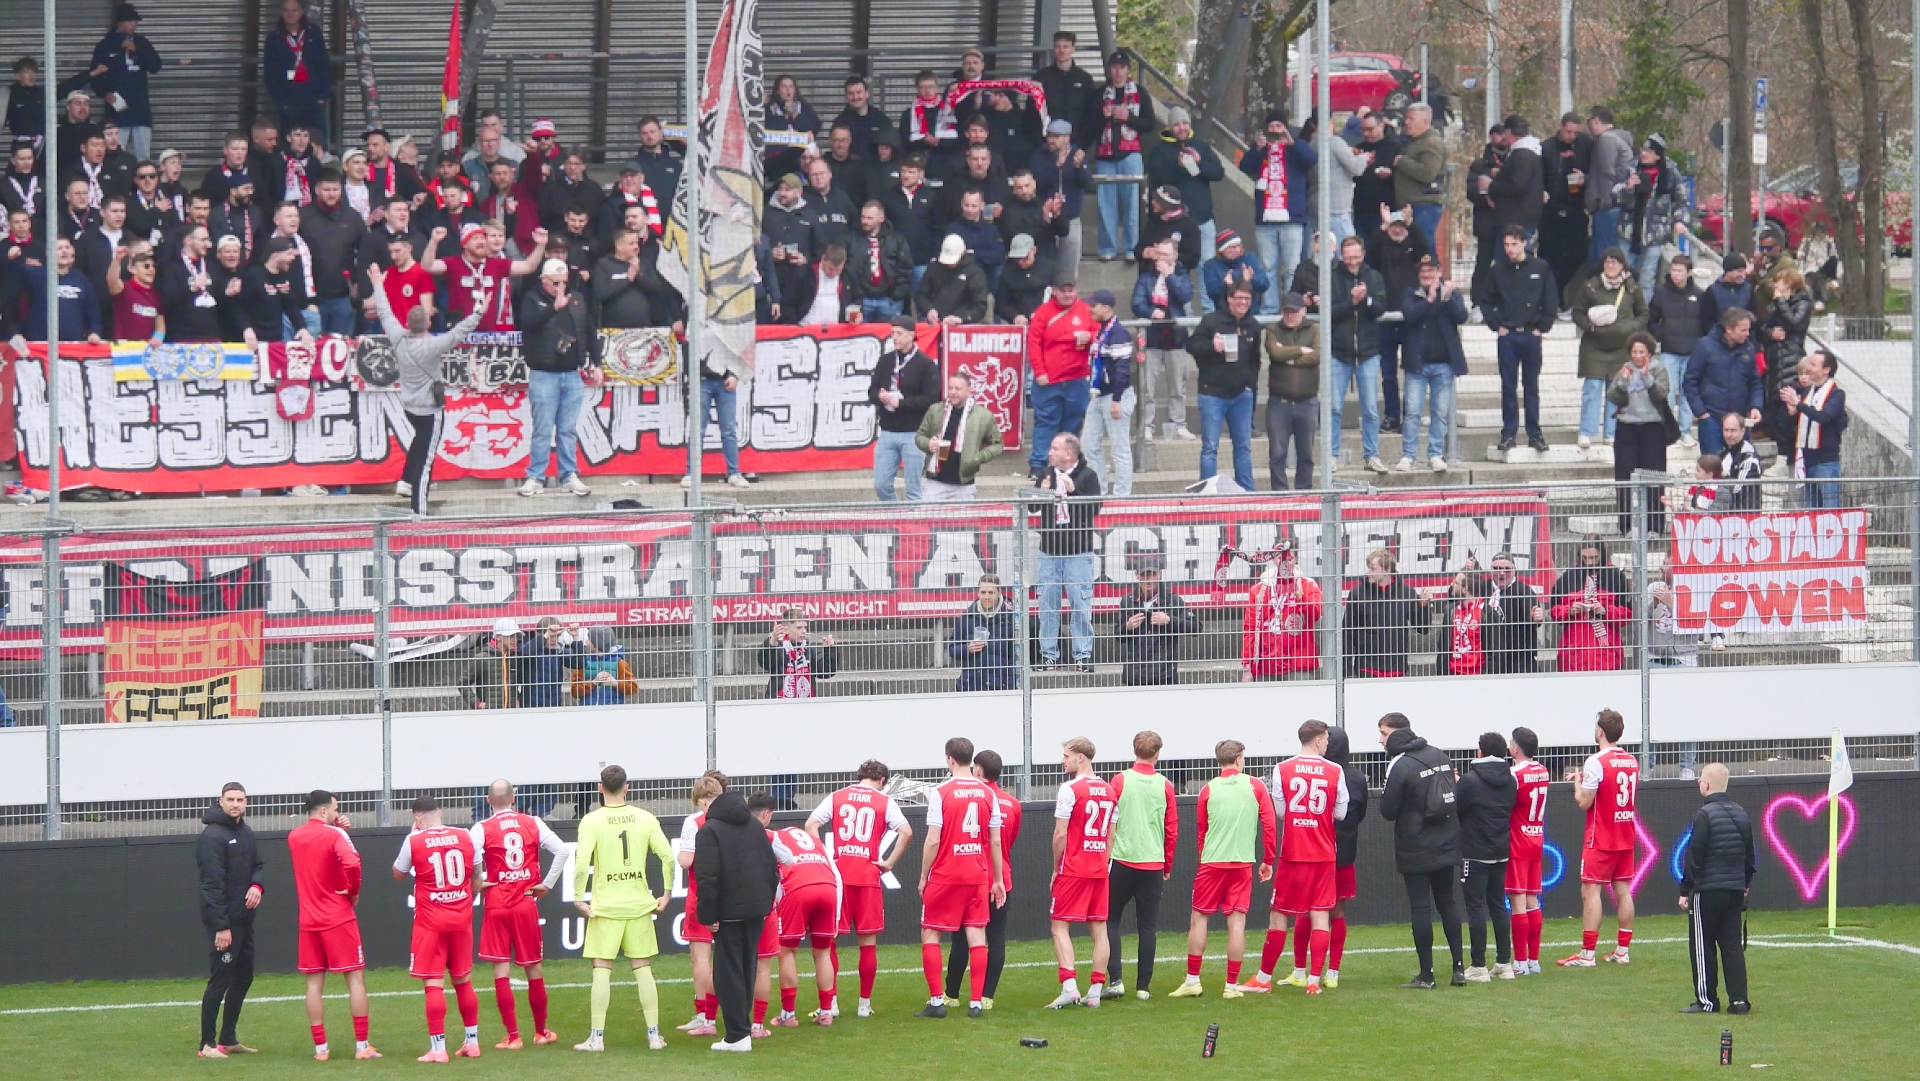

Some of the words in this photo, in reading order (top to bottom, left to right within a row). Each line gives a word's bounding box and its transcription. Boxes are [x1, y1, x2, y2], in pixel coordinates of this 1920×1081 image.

[1673, 510, 1865, 567] VORSTADT
[825, 599, 888, 616] NICHT
[1675, 574, 1867, 630] LÖWEN
[104, 618, 263, 674] HESSEN
[1295, 763, 1325, 775] DAHLKE
[848, 792, 872, 804] STARK
[953, 788, 985, 799] KNIPPING
[1289, 776, 1329, 815] 25
[1528, 786, 1549, 822] 17
[1616, 771, 1637, 807] 31
[500, 818, 521, 831] BRILL
[606, 814, 636, 825] WEYAND
[838, 804, 876, 843] 30
[962, 801, 981, 839] 4
[1084, 799, 1114, 837] 27
[503, 831, 525, 870] 8
[618, 830, 631, 867] 1
[789, 829, 816, 851] 9
[837, 844, 871, 856] POLYMA
[428, 849, 466, 889] 10
[498, 868, 532, 880] POLYMA
[606, 871, 643, 882] POLYMA
[430, 889, 468, 902] POLYMA
